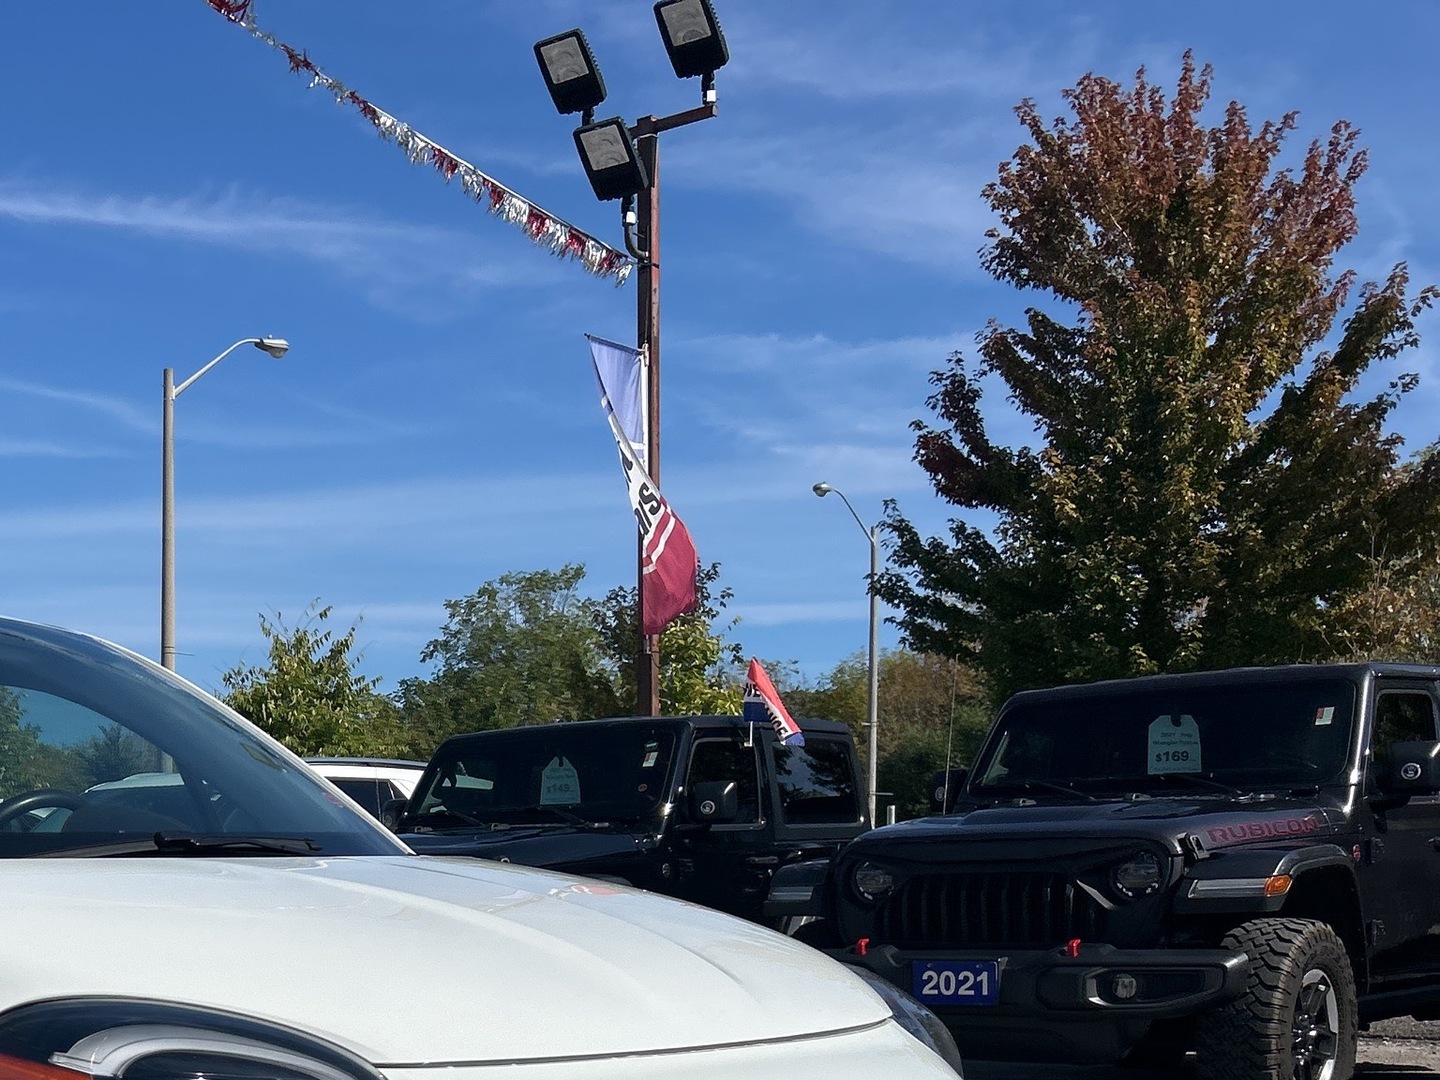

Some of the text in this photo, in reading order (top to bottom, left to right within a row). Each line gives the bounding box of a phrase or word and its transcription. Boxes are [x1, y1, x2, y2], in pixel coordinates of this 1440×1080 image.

[1155, 750, 1189, 762] $169
[1205, 816, 1318, 843] RUBICON
[921, 970, 989, 996] 2021
